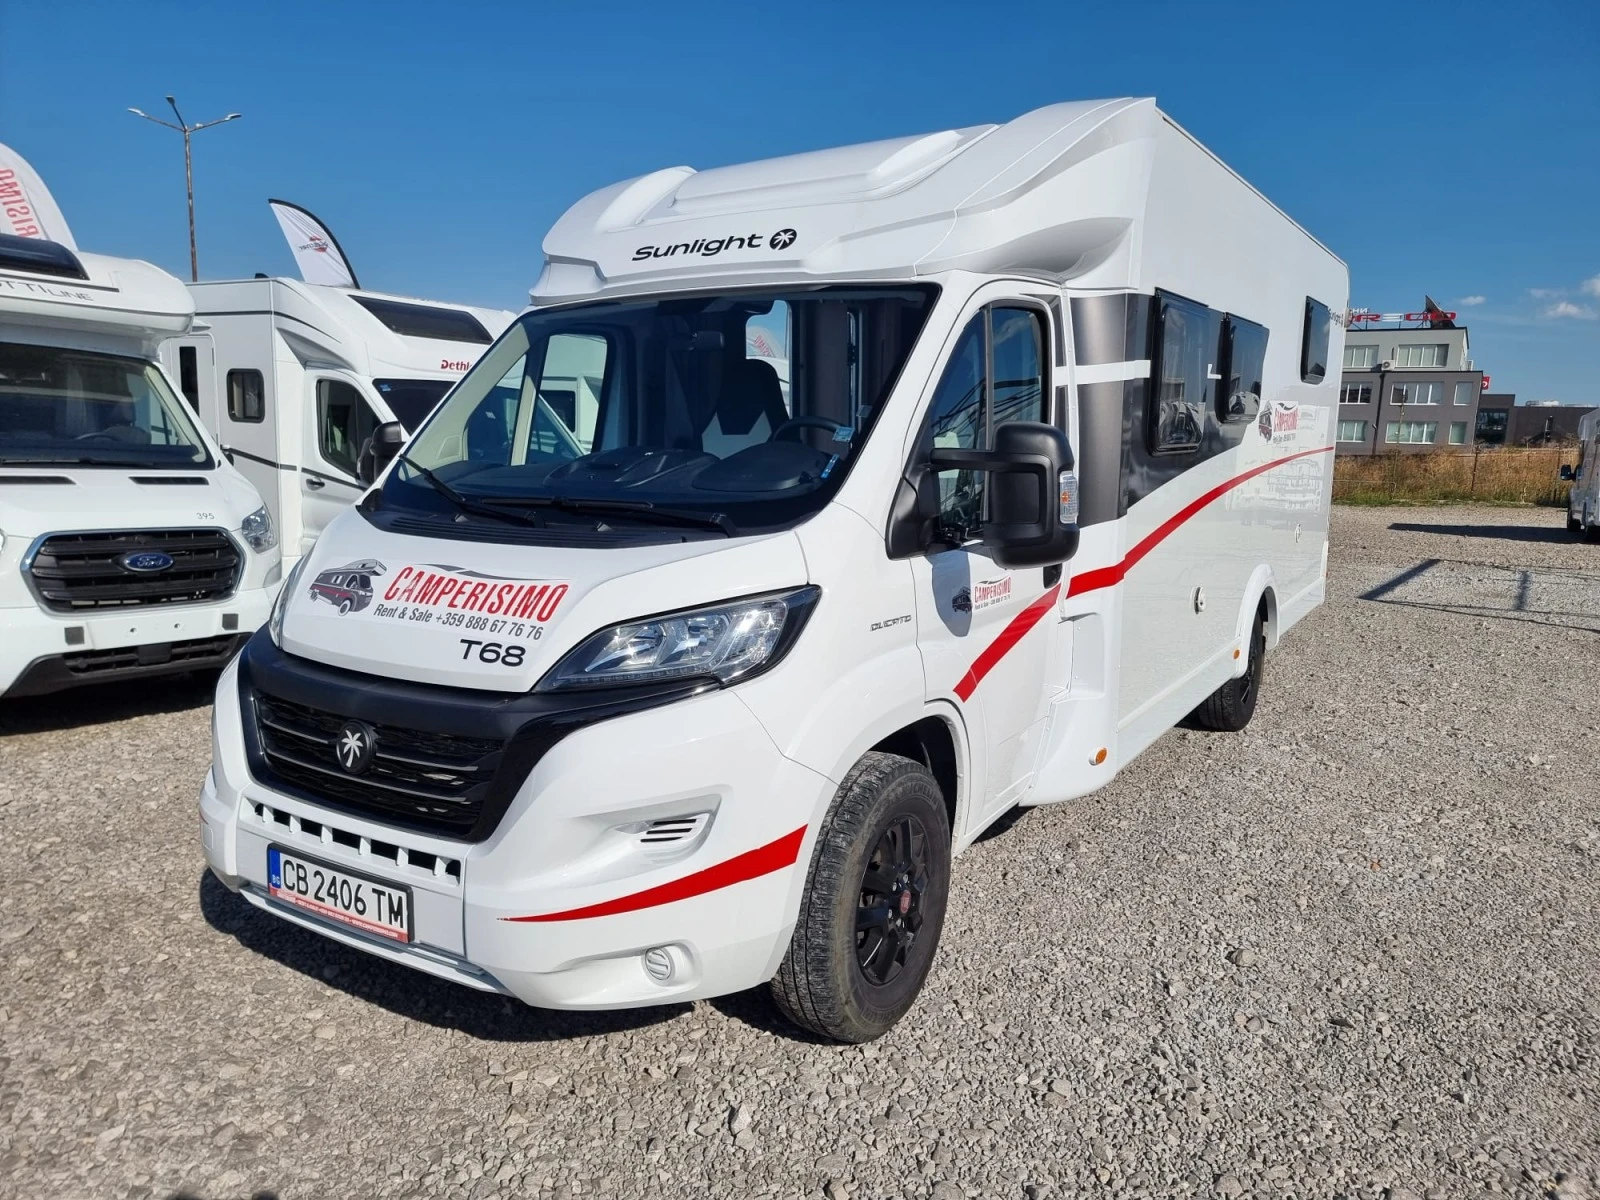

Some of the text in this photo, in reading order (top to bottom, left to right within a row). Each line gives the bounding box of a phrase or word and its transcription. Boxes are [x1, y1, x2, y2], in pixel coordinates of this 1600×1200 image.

[632, 234, 763, 261] Sunlight
[441, 359, 472, 371] Dethl
[196, 512, 215, 521] 395
[137, 555, 164, 567] Ford
[384, 566, 569, 622] CAMPERISIMO
[373, 603, 544, 641] Rent & Sale +359 888 67 76 76
[871, 614, 912, 631] DUCATO
[460, 638, 526, 667] T68
[283, 860, 309, 896] CB
[313, 870, 367, 916] 2406
[372, 887, 404, 929] TM
